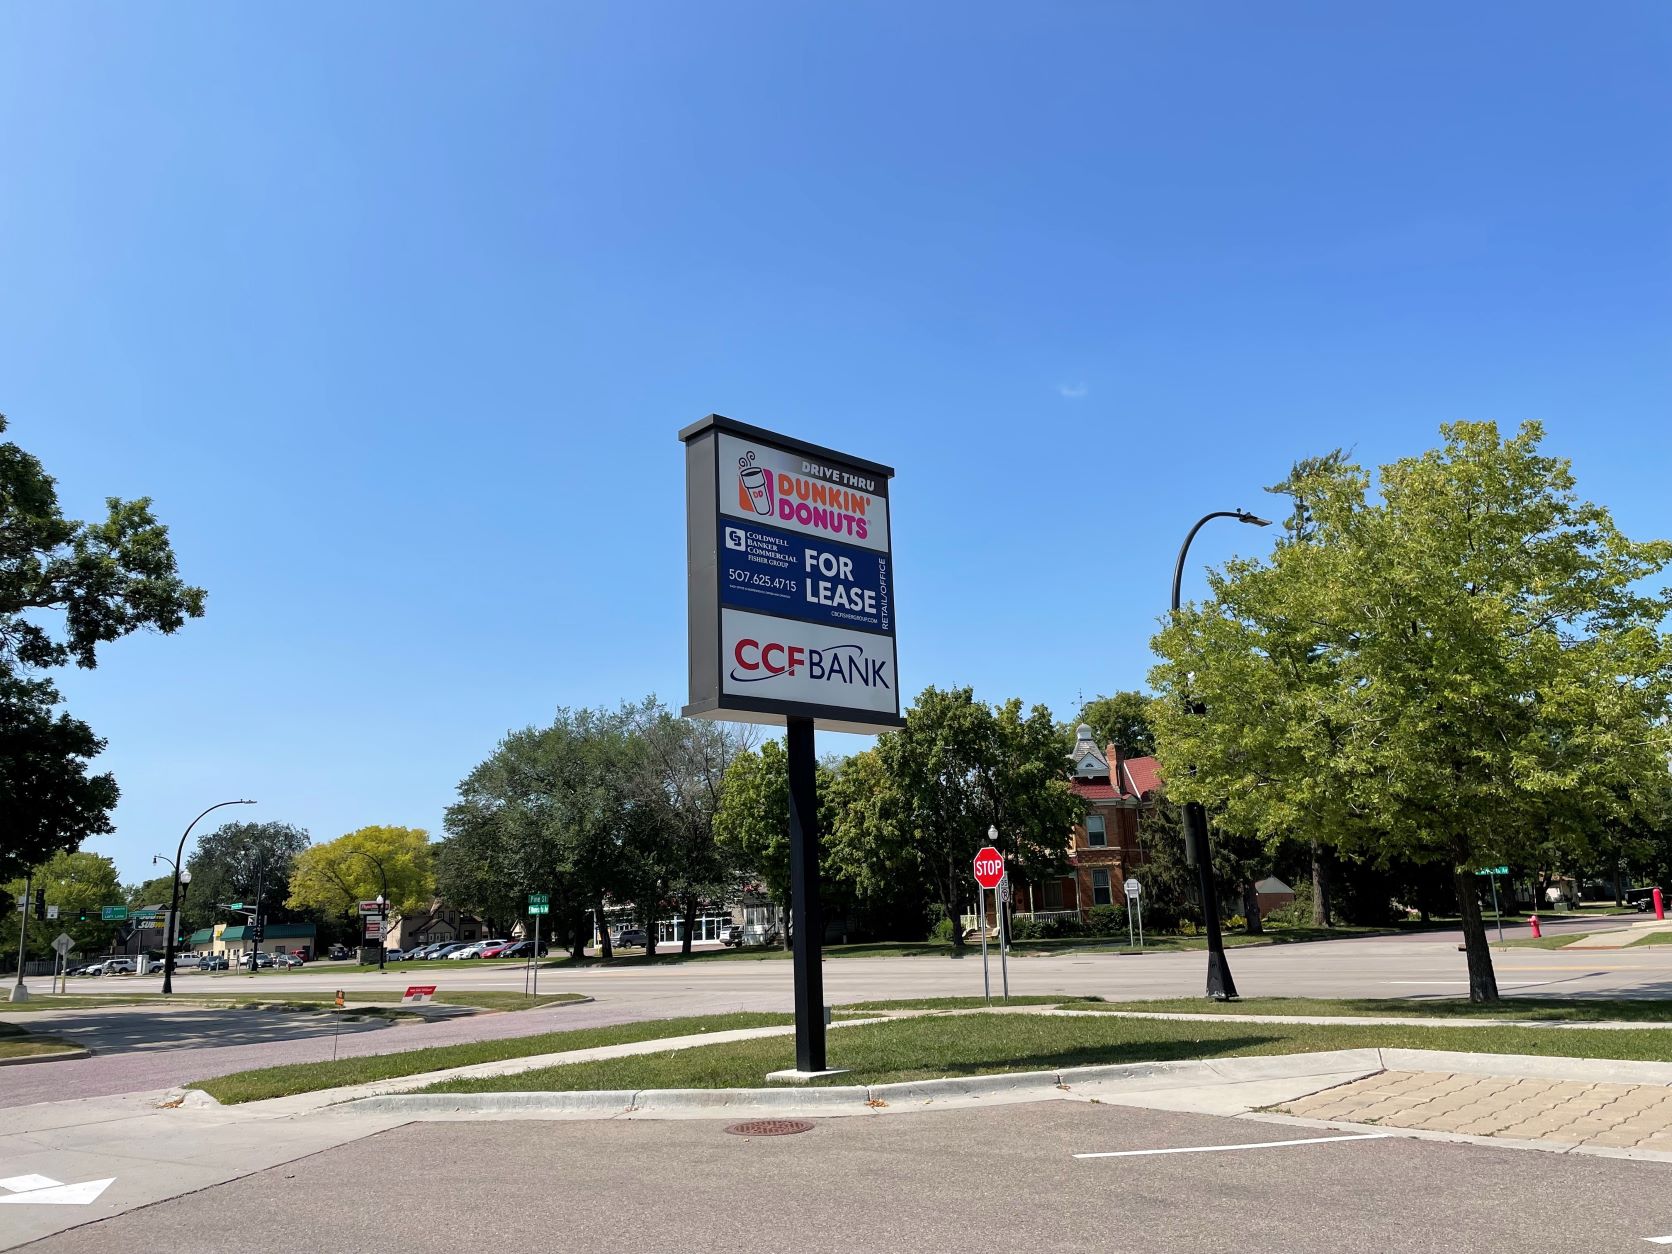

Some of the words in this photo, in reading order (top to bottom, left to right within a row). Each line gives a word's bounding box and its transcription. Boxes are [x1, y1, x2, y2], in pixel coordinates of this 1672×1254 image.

[801, 461, 840, 482] DRIVE
[842, 472, 875, 491] THRU
[778, 473, 871, 516] DUNKIN'
[778, 497, 868, 540] DONUTS
[747, 531, 789, 547] COLDWELL
[747, 538, 778, 552] BANKER
[747, 546, 798, 563] COMMERCIAL
[747, 554, 768, 564] FISHER
[768, 559, 789, 568] GROUP
[805, 548, 854, 581] FOR
[729, 568, 797, 592] 507.625.4715
[878, 557, 889, 630] RETAIL/OFFICE
[805, 577, 877, 614] LEASE
[976, 860, 1002, 876] STOP
